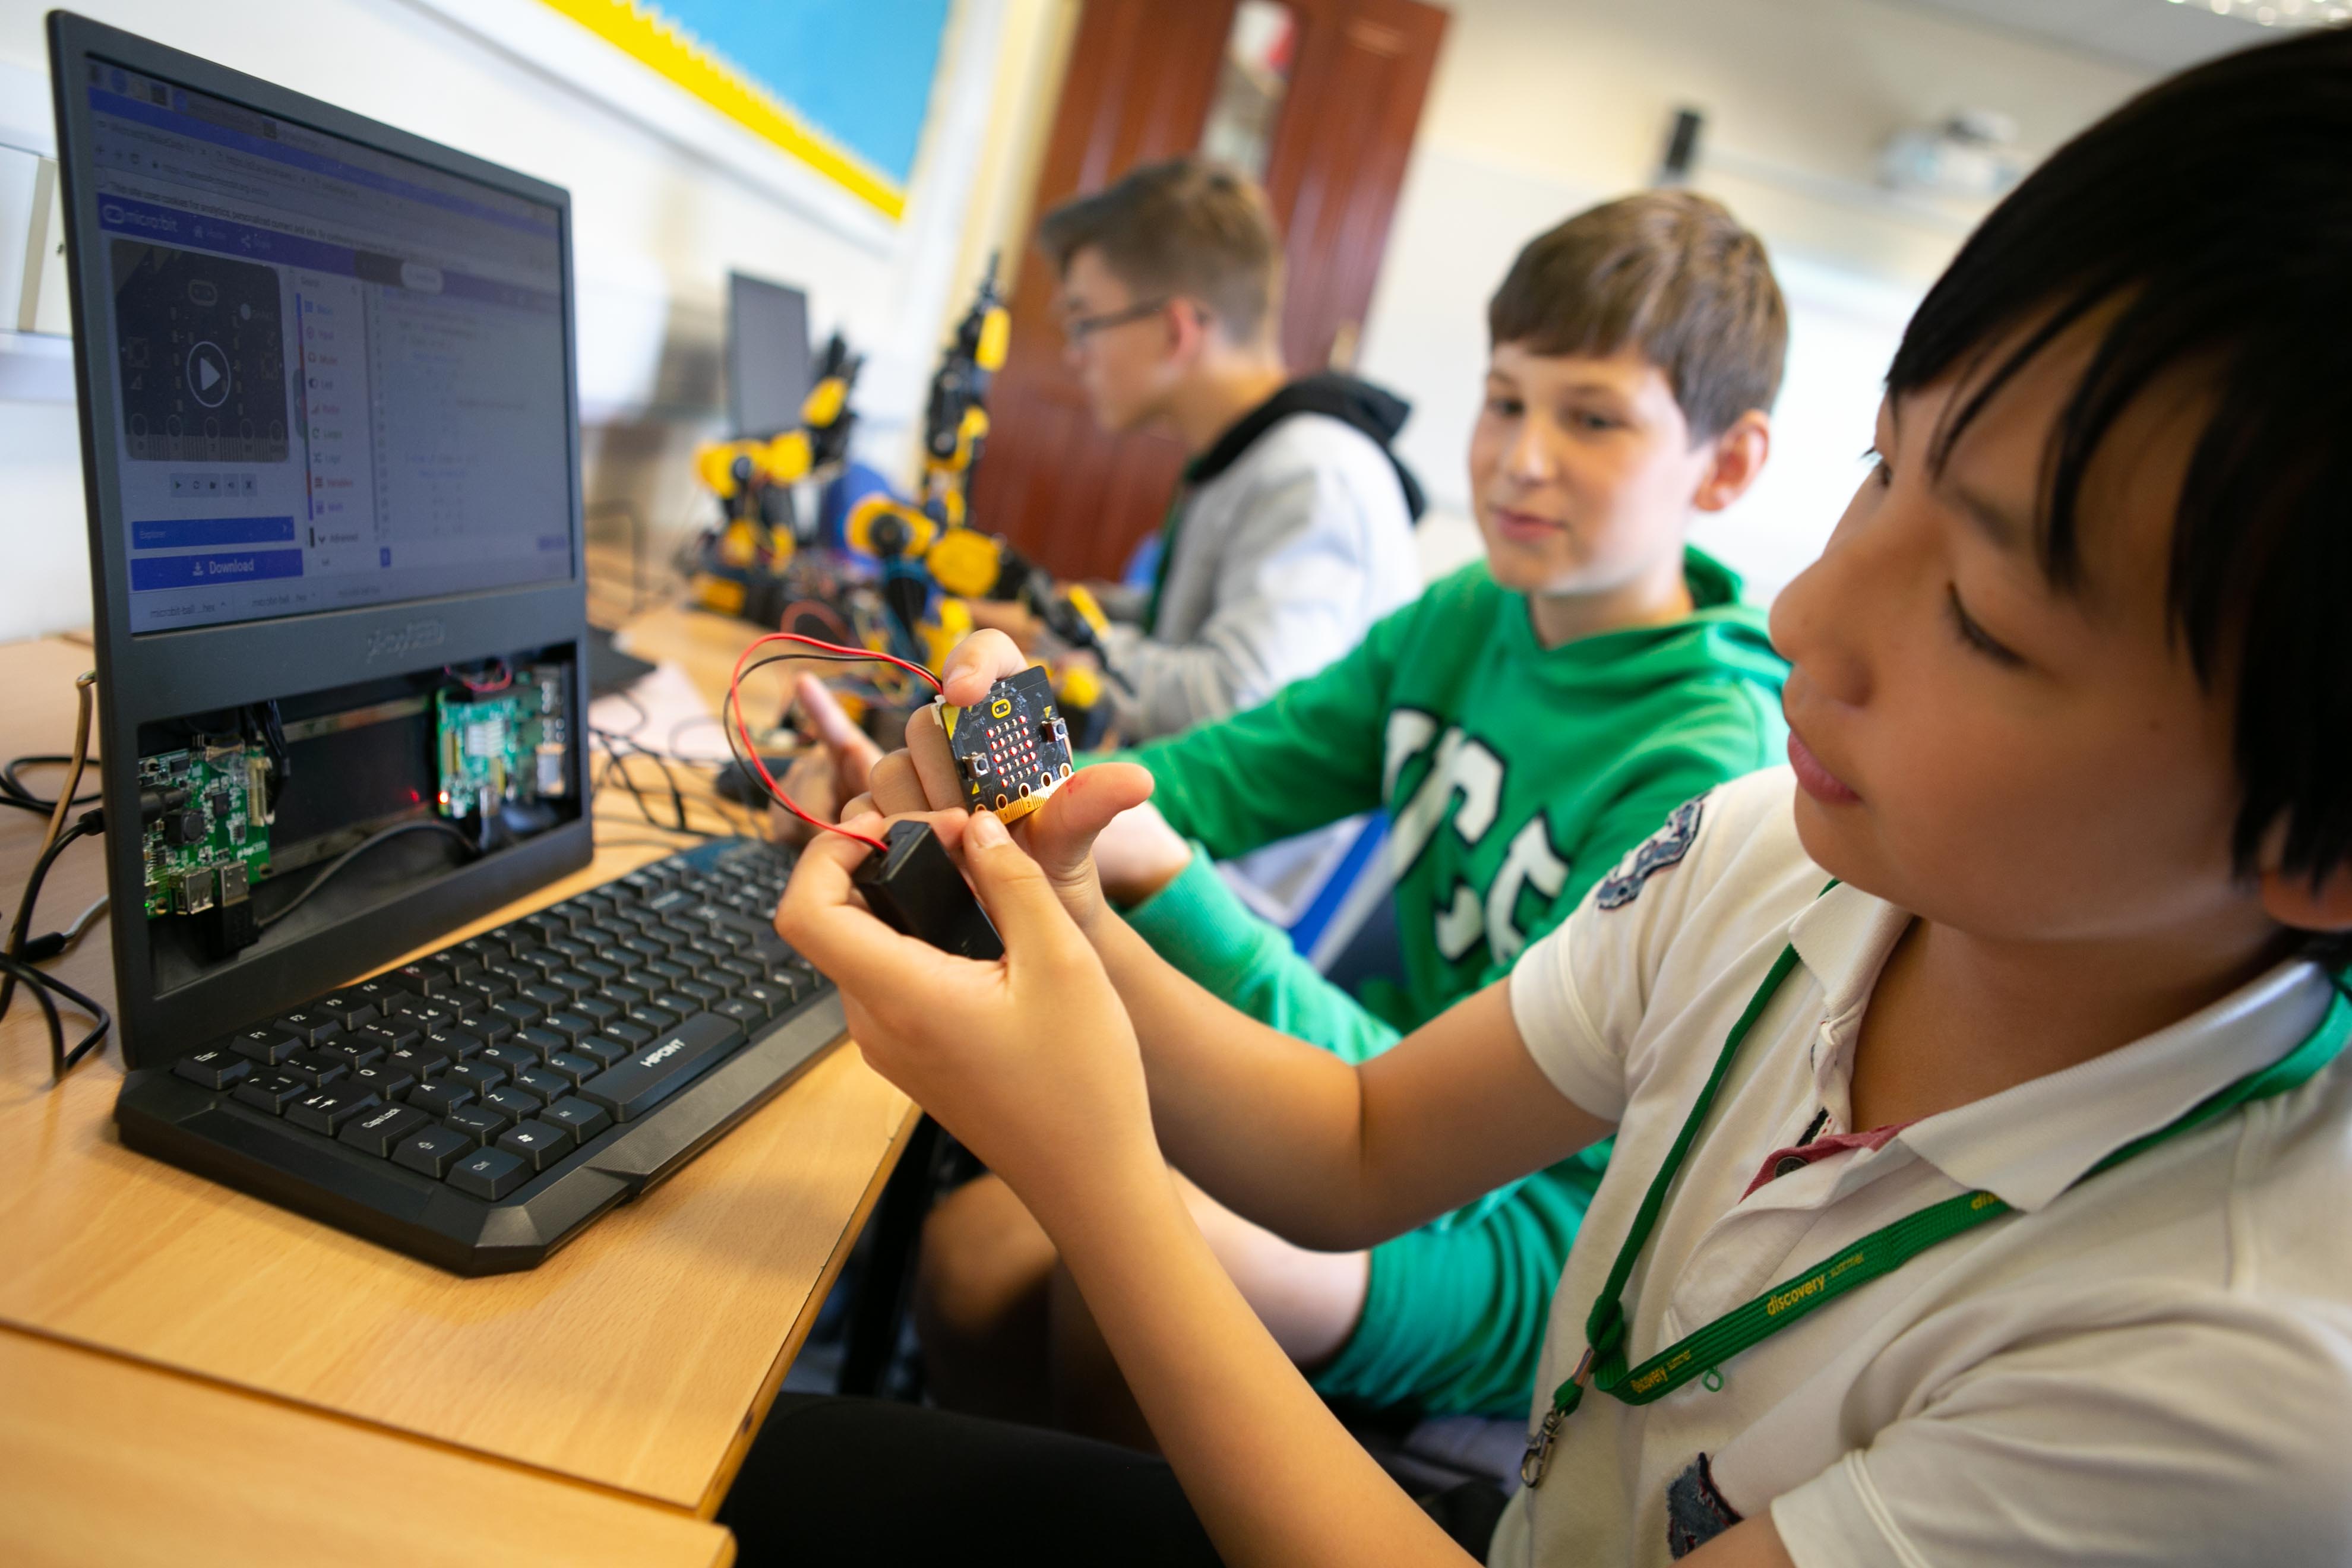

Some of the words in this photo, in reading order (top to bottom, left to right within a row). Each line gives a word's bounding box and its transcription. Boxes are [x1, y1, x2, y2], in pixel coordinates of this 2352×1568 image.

[125, 207, 178, 234] micro:bit
[208, 558, 255, 577] Download
[289, 1014, 307, 1022] F2
[249, 1031, 268, 1039] F1
[431, 1033, 446, 1043] E
[193, 1051, 219, 1063] Esc
[394, 1049, 413, 1058] W
[485, 1048, 500, 1057] D
[551, 1058, 565, 1067] C
[359, 1068, 377, 1077] Q
[454, 1065, 470, 1073] S
[520, 1076, 536, 1084] X
[421, 1083, 437, 1092] A
[488, 1093, 504, 1103] Z
[1766, 1273, 1826, 1316] discovery
